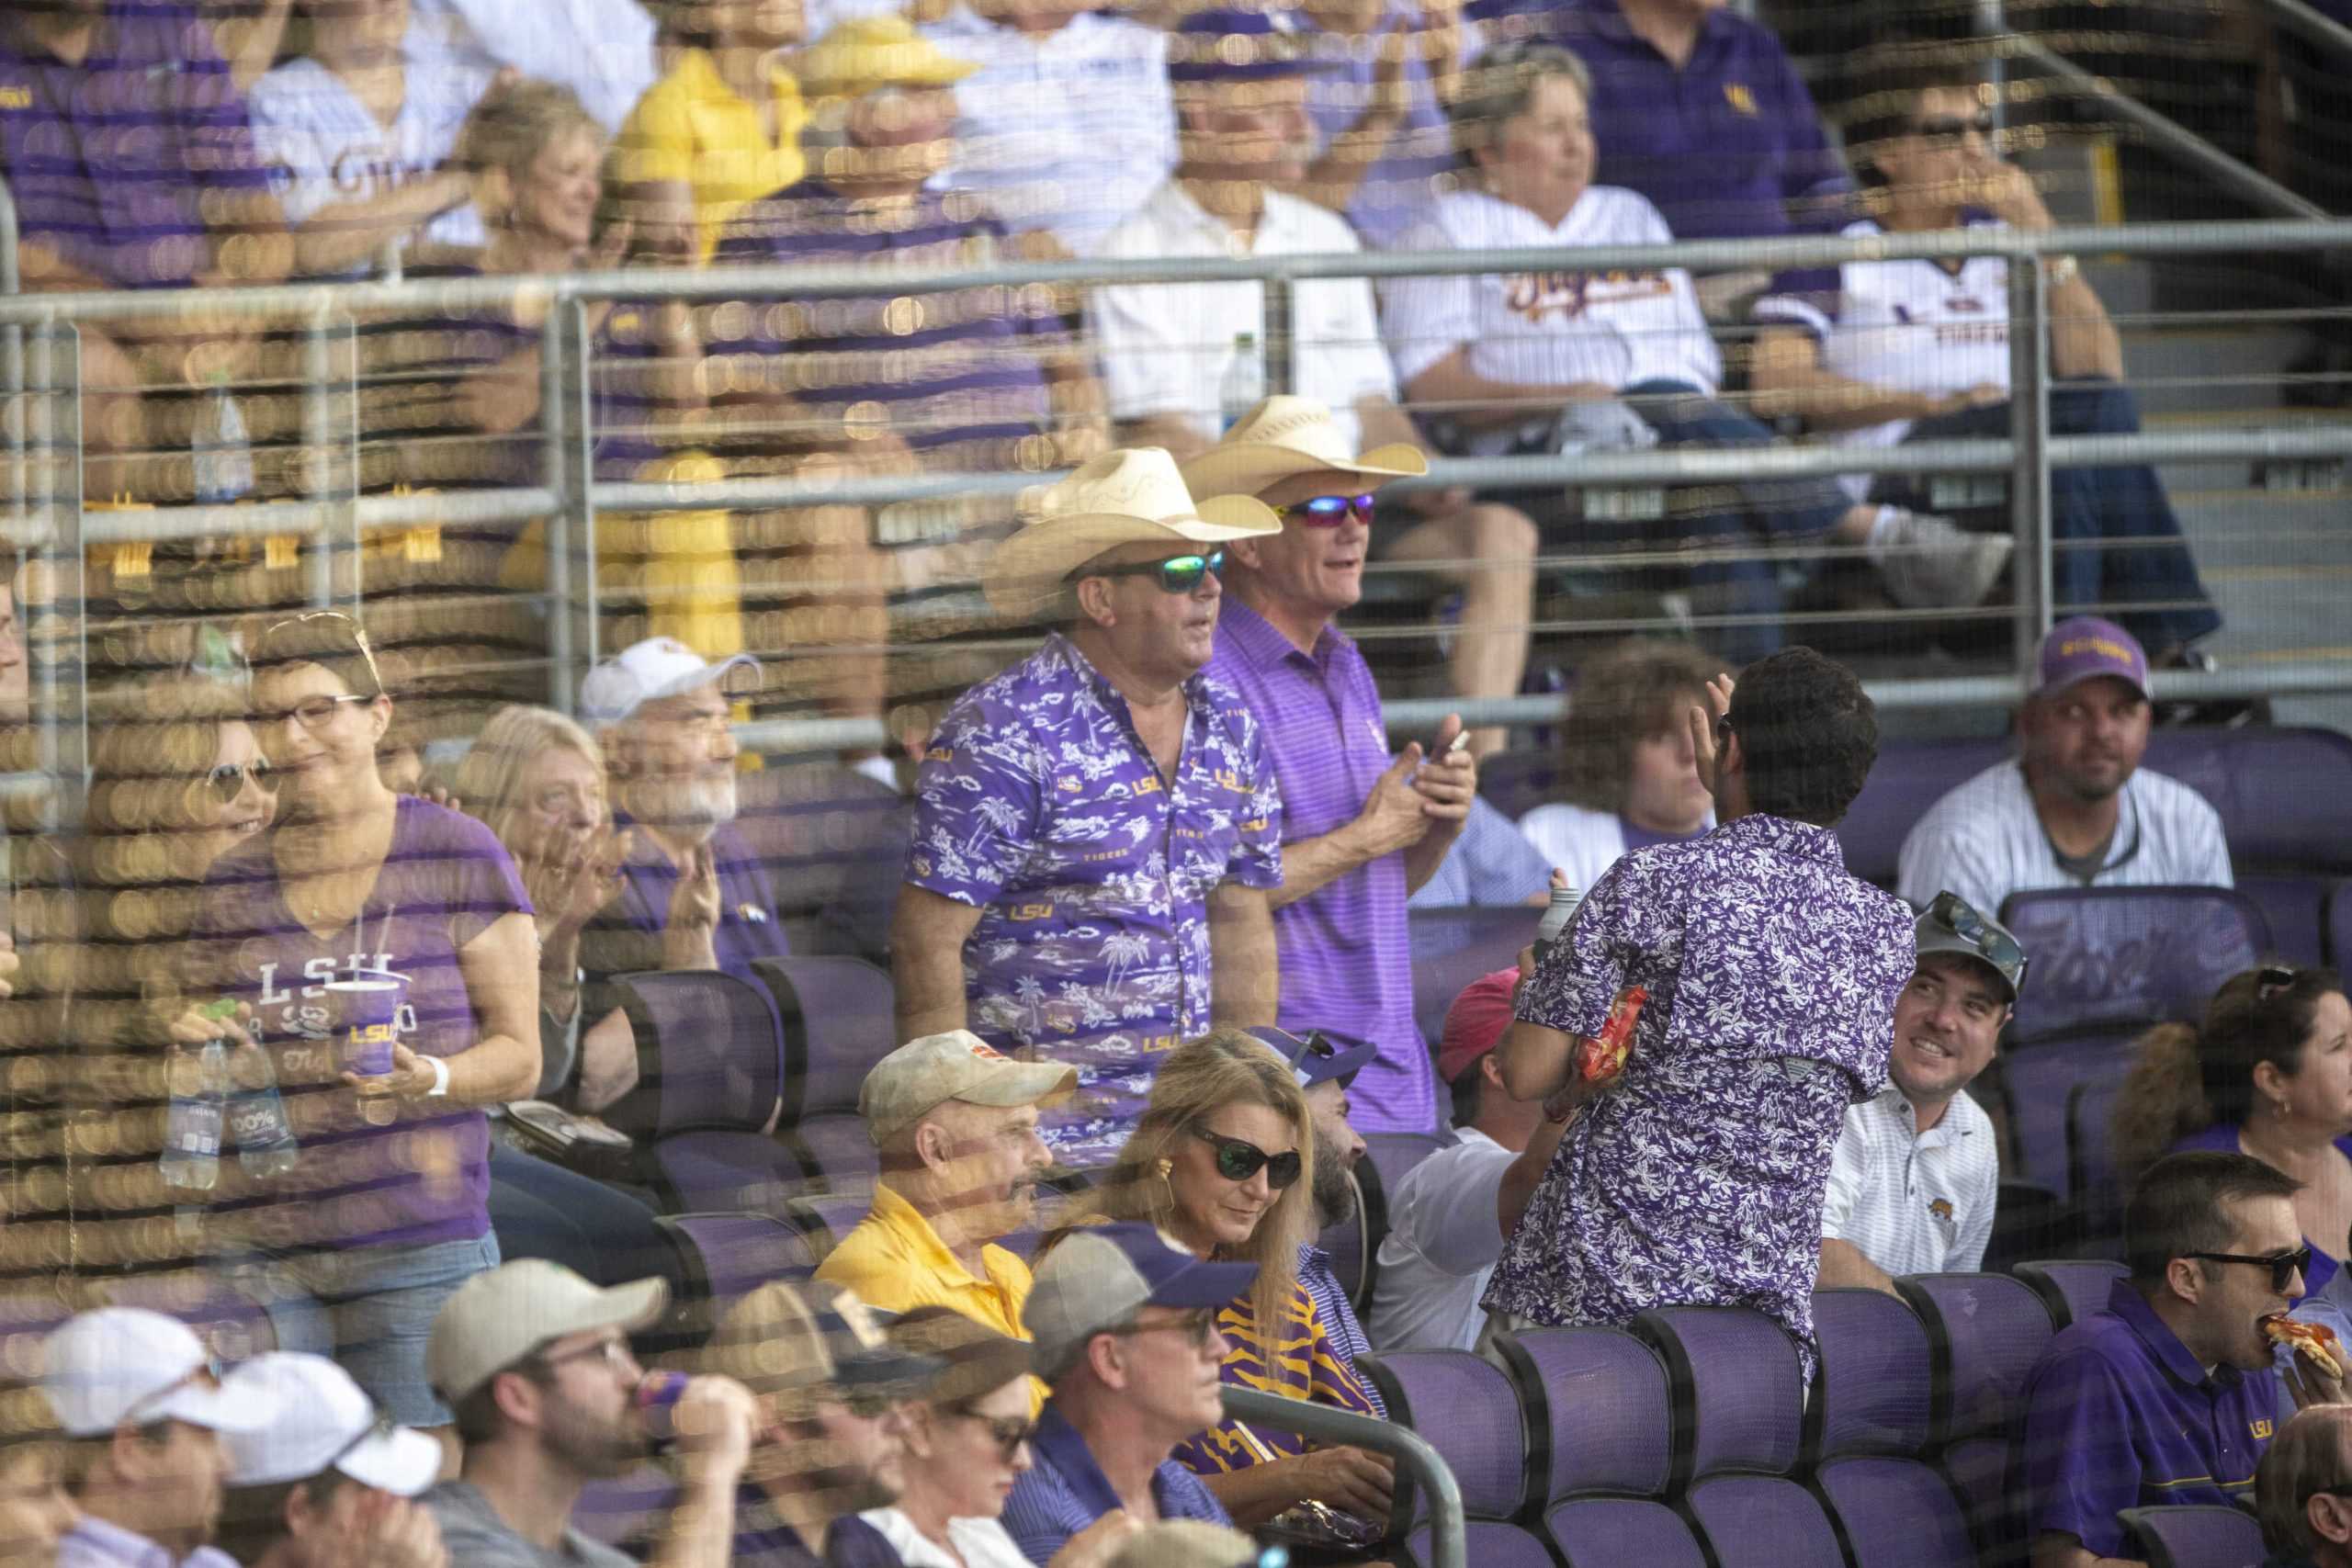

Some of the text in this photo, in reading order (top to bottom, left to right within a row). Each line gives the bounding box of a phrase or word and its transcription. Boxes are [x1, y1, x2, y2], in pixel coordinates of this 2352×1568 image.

[1010, 903, 1054, 921] LSU
[349, 1023, 398, 1044] LSU
[2249, 1418, 2273, 1440] LSU
